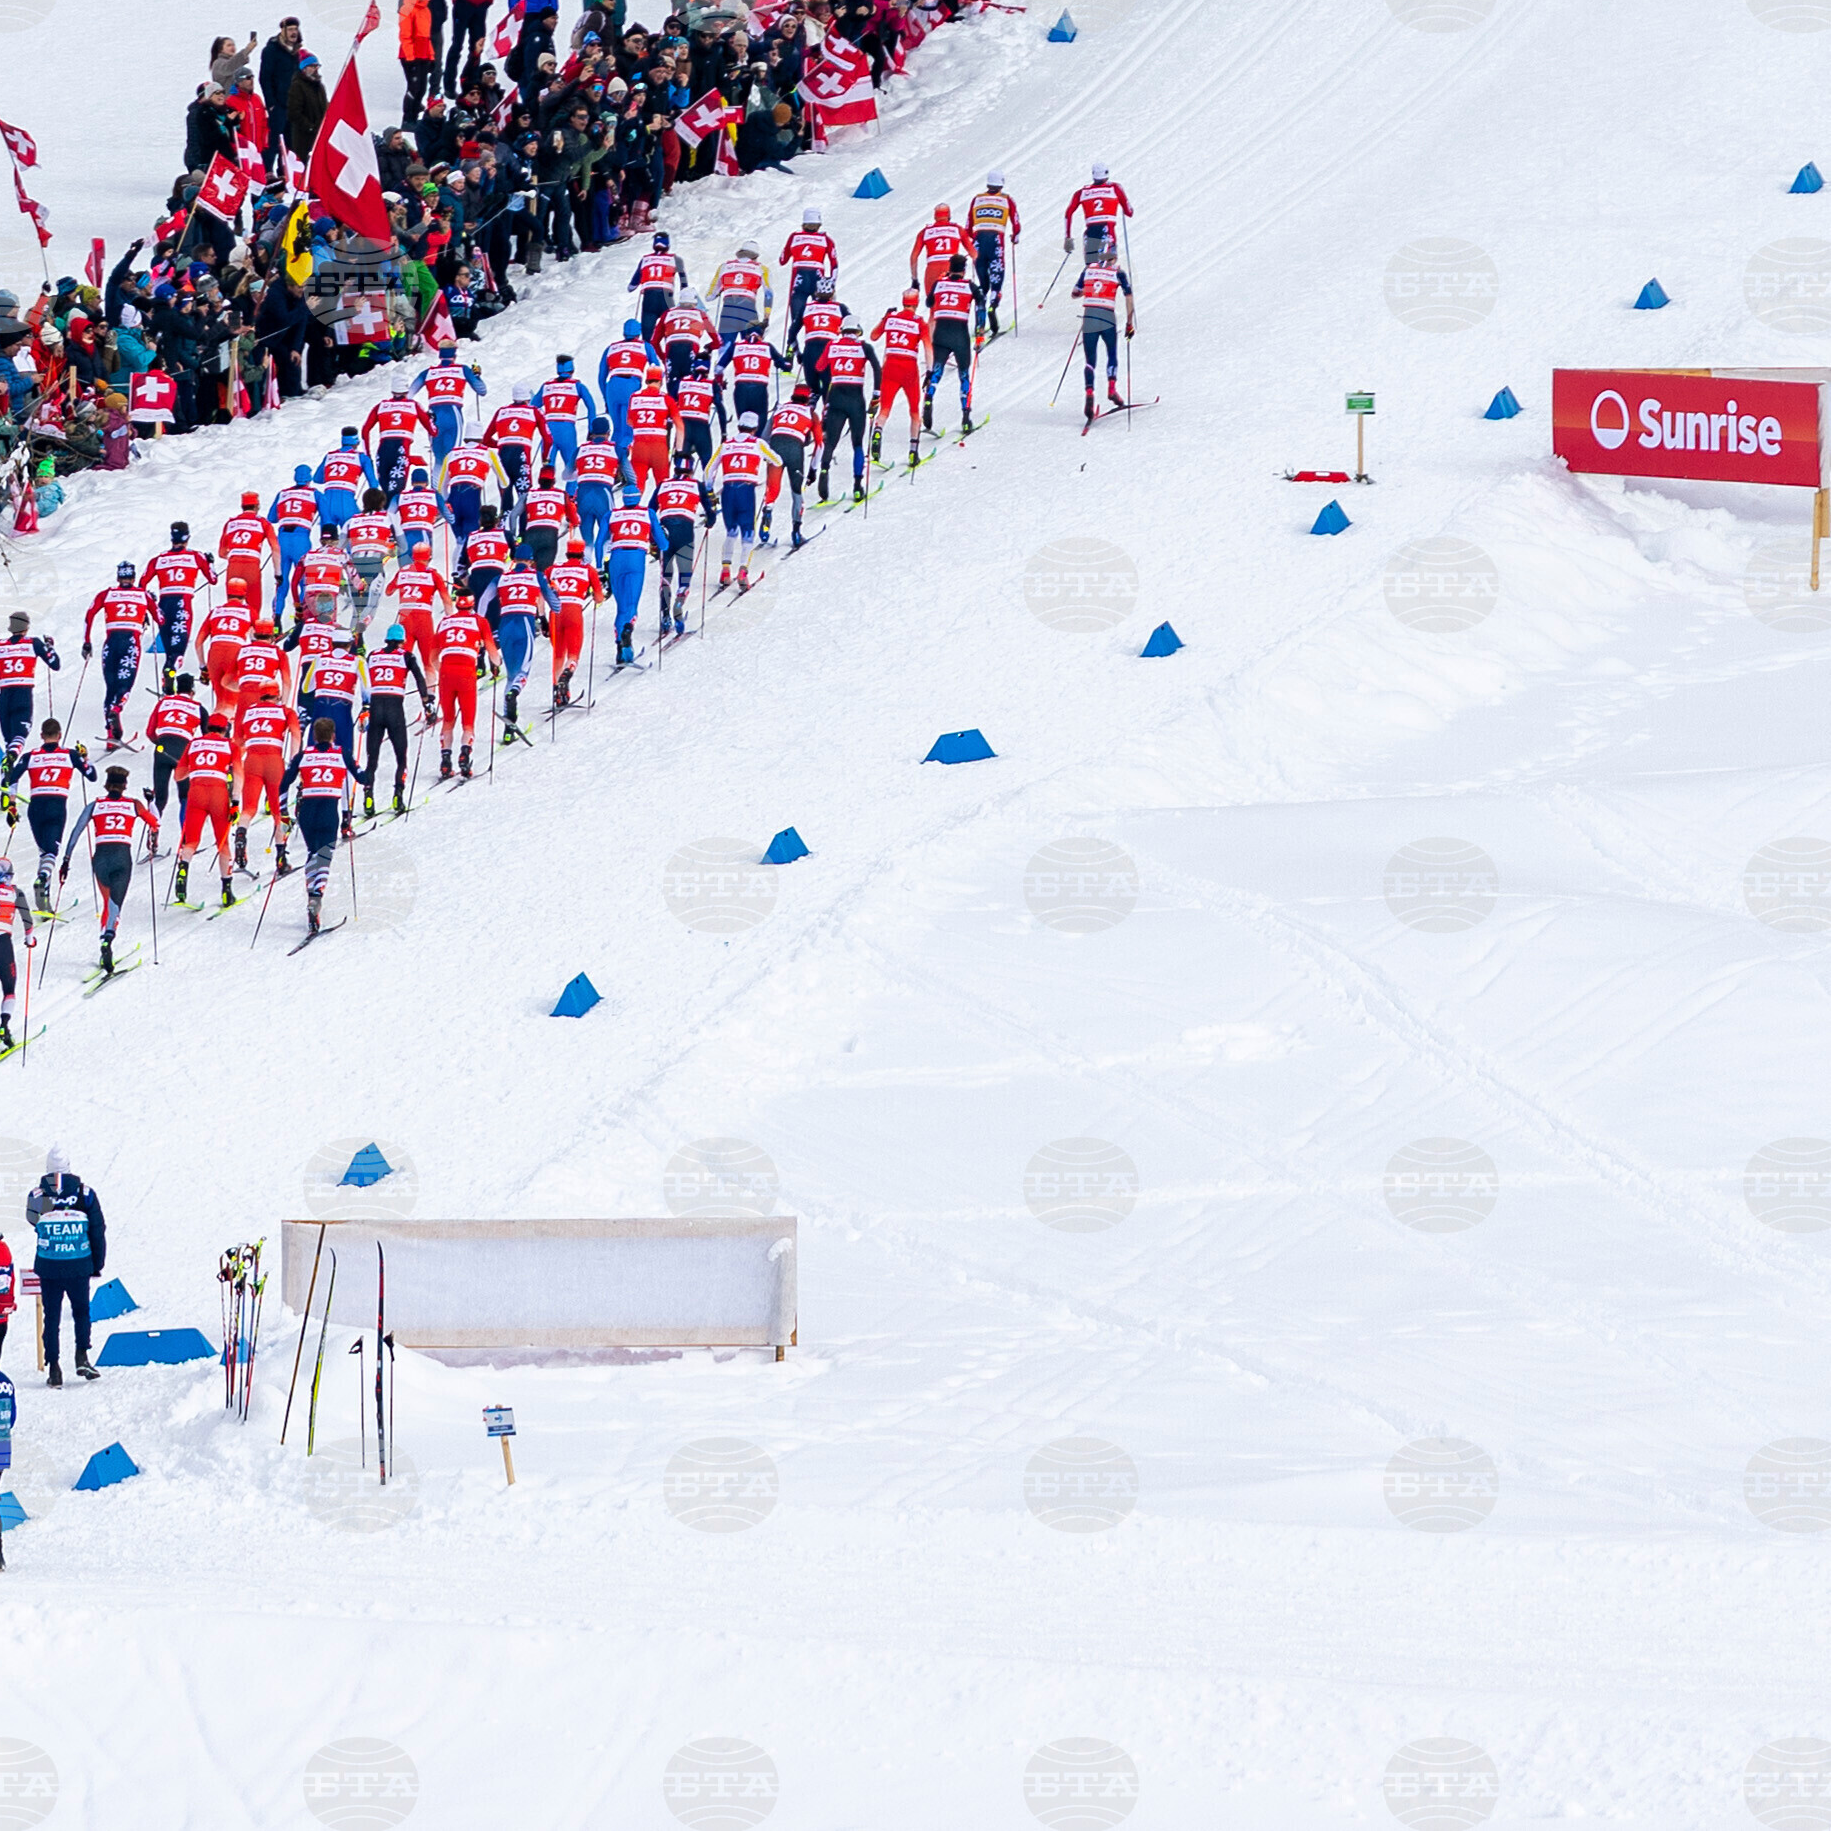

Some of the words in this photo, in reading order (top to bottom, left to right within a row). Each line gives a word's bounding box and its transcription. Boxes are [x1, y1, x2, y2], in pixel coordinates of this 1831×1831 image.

[1093, 199, 1104, 212] 2
[976, 207, 1003, 219] coop
[801, 245, 813, 258] 4
[935, 238, 951, 251] 21
[648, 265, 663, 278] 11
[733, 272, 744, 286] 8
[1093, 280, 1103, 294] 9
[939, 293, 959, 307] 25
[673, 318, 691, 331] 12
[812, 314, 830, 328] 13
[889, 331, 910, 346] 34
[620, 351, 631, 365] 5
[742, 356, 760, 370] 18
[833, 358, 855, 372] 46
[434, 378, 456, 392] 42
[549, 395, 566, 409] 17
[683, 393, 701, 408] 14
[391, 412, 402, 426] 3
[637, 410, 656, 424] 32
[778, 412, 799, 425] 20
[508, 419, 520, 432] 6
[1638, 398, 1783, 457] Sunrise
[458, 459, 478, 471] 19
[584, 456, 606, 470] 35
[729, 455, 747, 469] 41
[328, 463, 349, 477] 29
[667, 491, 688, 505] 37
[284, 500, 303, 513] 15
[407, 504, 429, 518] 38
[536, 502, 557, 516] 50
[357, 527, 379, 541] 33
[619, 521, 642, 536] 40
[232, 531, 252, 545] 49
[476, 542, 496, 556] 31
[166, 568, 186, 582] 16
[316, 565, 327, 580] 7
[402, 585, 423, 599] 24
[559, 578, 578, 592] 62
[508, 585, 529, 600] 22
[116, 603, 138, 618] 23
[217, 617, 240, 632] 48
[445, 628, 467, 643] 56
[308, 636, 330, 651] 55
[3, 658, 25, 674] 36
[244, 657, 266, 671] 58
[322, 671, 345, 686] 59
[374, 667, 395, 682] 28
[163, 711, 188, 725] 43
[249, 719, 273, 734] 64
[195, 752, 218, 766] 60
[39, 768, 61, 782] 47
[311, 767, 334, 783] 26
[104, 815, 126, 830] 52
[45, 1223, 84, 1235] TEAM
[55, 1244, 75, 1252] FRA
